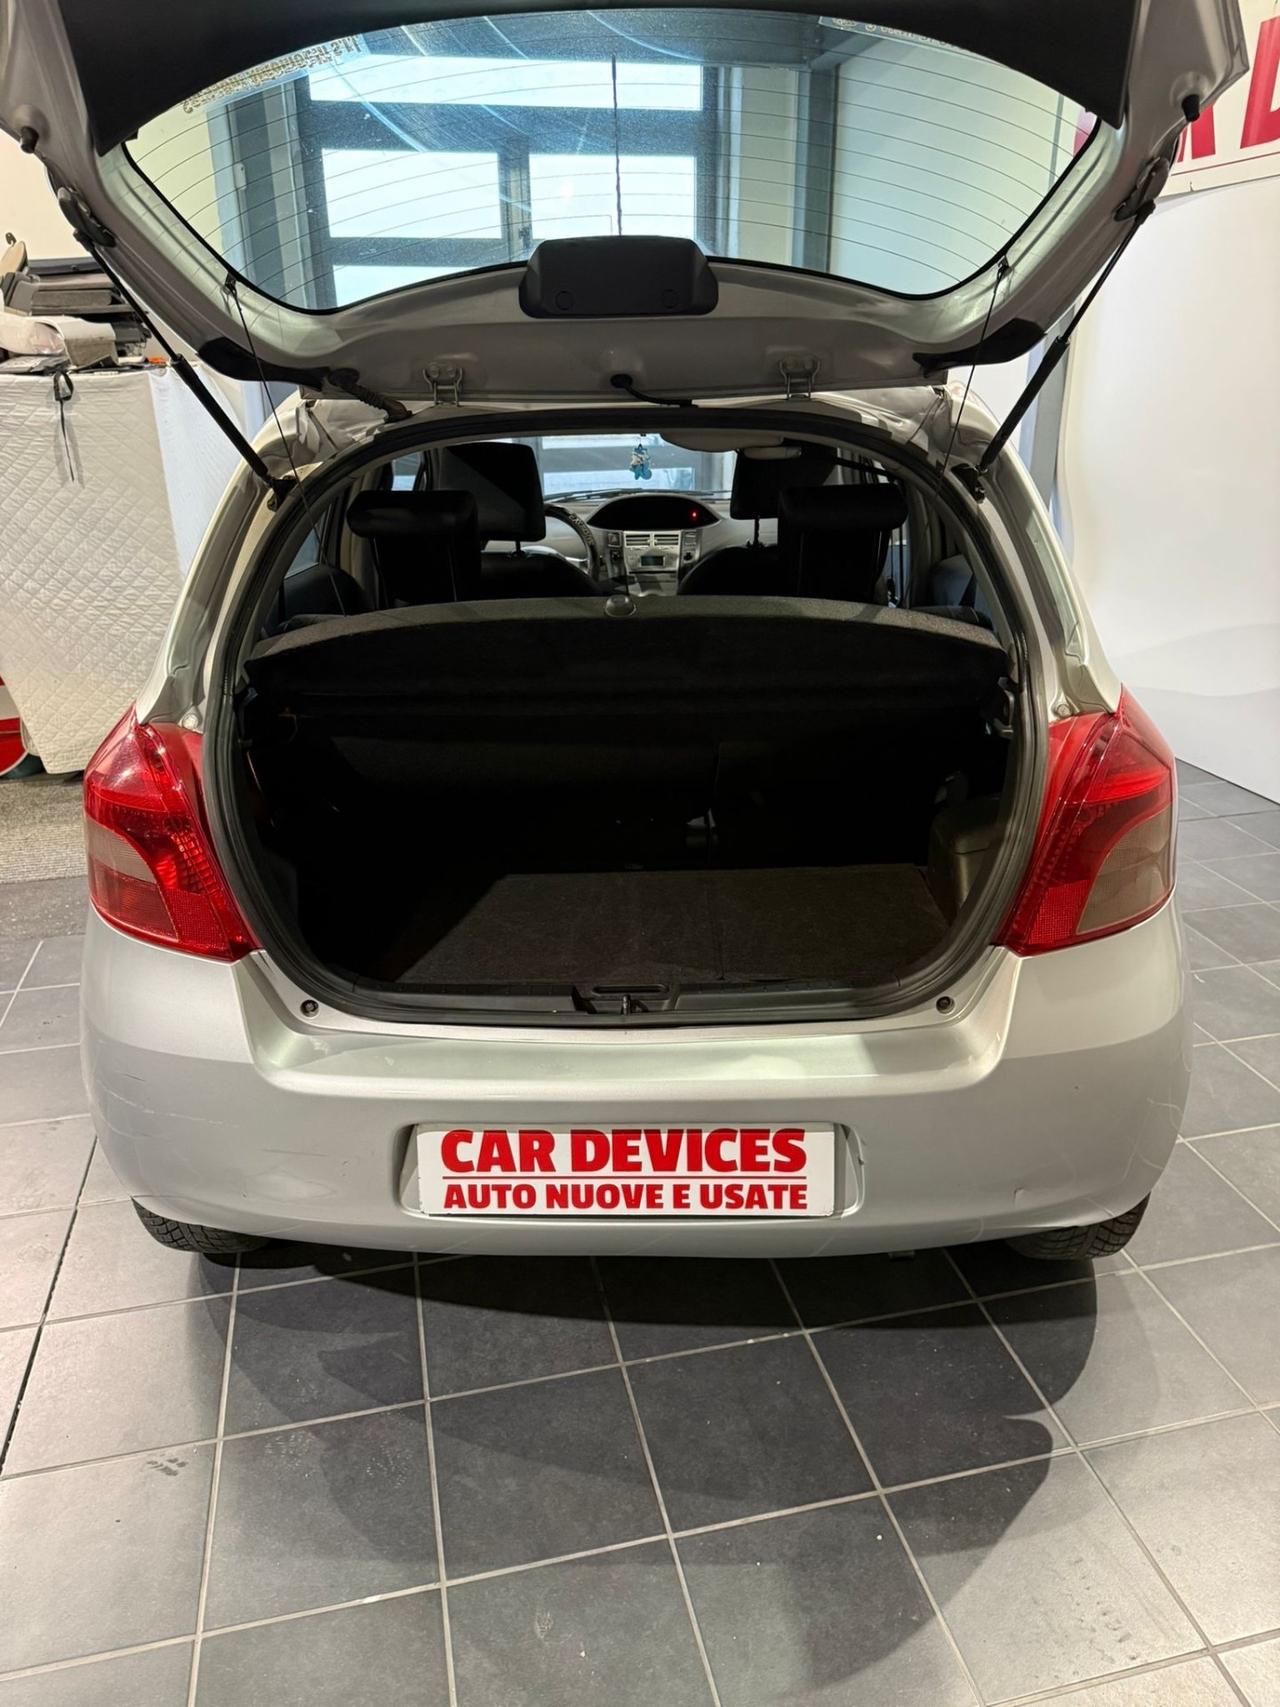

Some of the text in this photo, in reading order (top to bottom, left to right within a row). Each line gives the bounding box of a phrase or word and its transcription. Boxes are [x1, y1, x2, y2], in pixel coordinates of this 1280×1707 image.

[440, 1128, 807, 1172] CAR DEVICES
[443, 1183, 808, 1210] AUTO NUOVE E USATE
